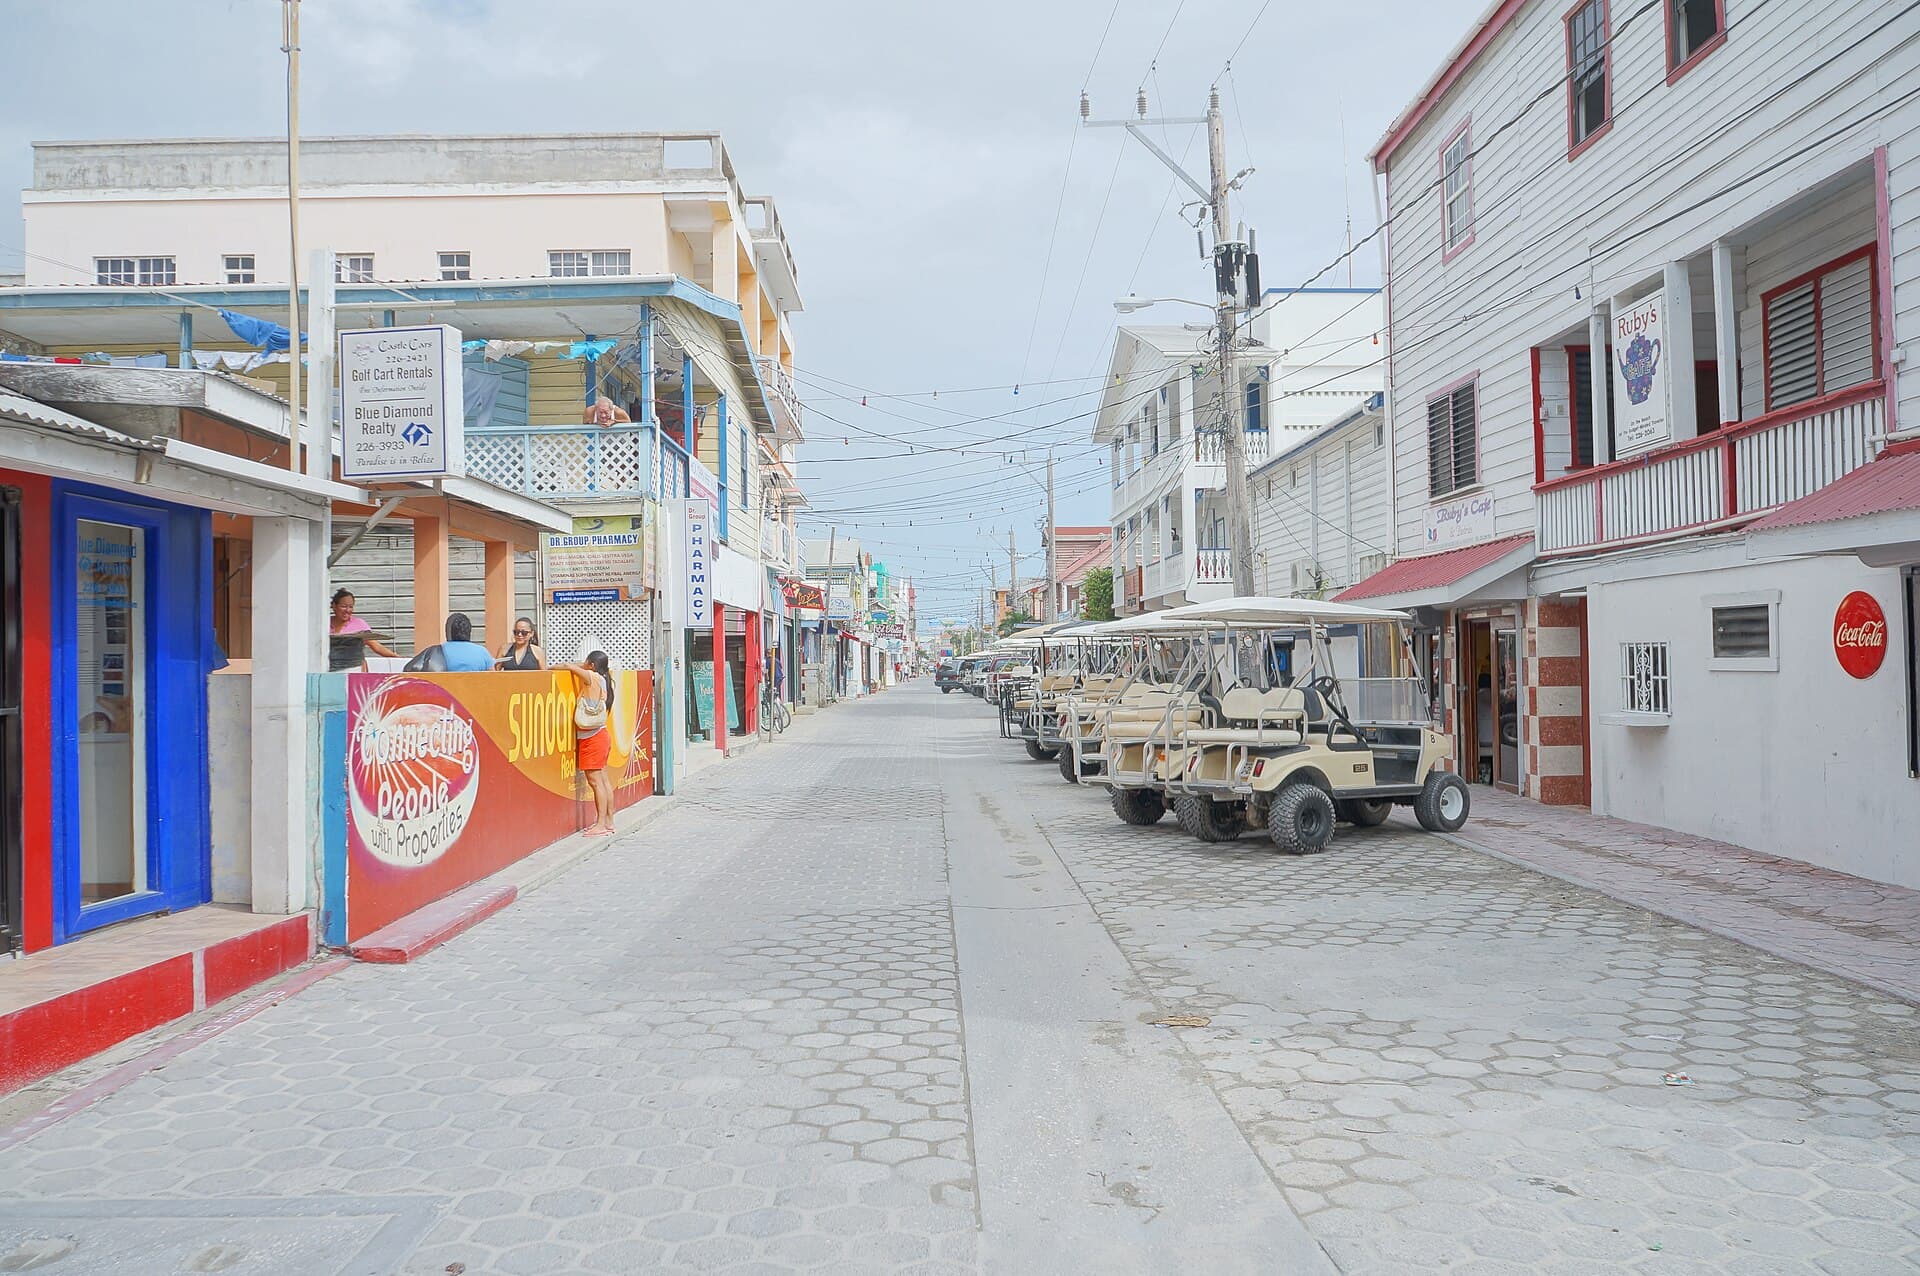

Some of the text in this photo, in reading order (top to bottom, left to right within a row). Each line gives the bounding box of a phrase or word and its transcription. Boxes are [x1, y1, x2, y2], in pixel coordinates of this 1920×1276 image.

[1617, 304, 1657, 339] Ruby's
[378, 338, 432, 352] Castle Cars
[352, 366, 433, 381] Golf Cart Rentals
[1627, 356, 1651, 380] CAFE
[355, 404, 433, 419] Blue Diamond
[362, 422, 396, 436] Realty
[356, 441, 404, 451] 226-3933
[356, 456, 386, 466] Paradise
[410, 454, 434, 465] Belize
[1437, 503, 1468, 524] Ruby's
[79, 536, 94, 554] lue
[550, 534, 638, 546] DR.GROUP PHARMACY
[691, 524, 705, 620] PHARMACY
[1836, 620, 1884, 647] Coca-Cola
[508, 672, 576, 763] sundan
[356, 704, 473, 774] Connecting
[1430, 734, 1436, 744] 8
[561, 751, 577, 780] Real
[371, 805, 463, 864] with Properties
